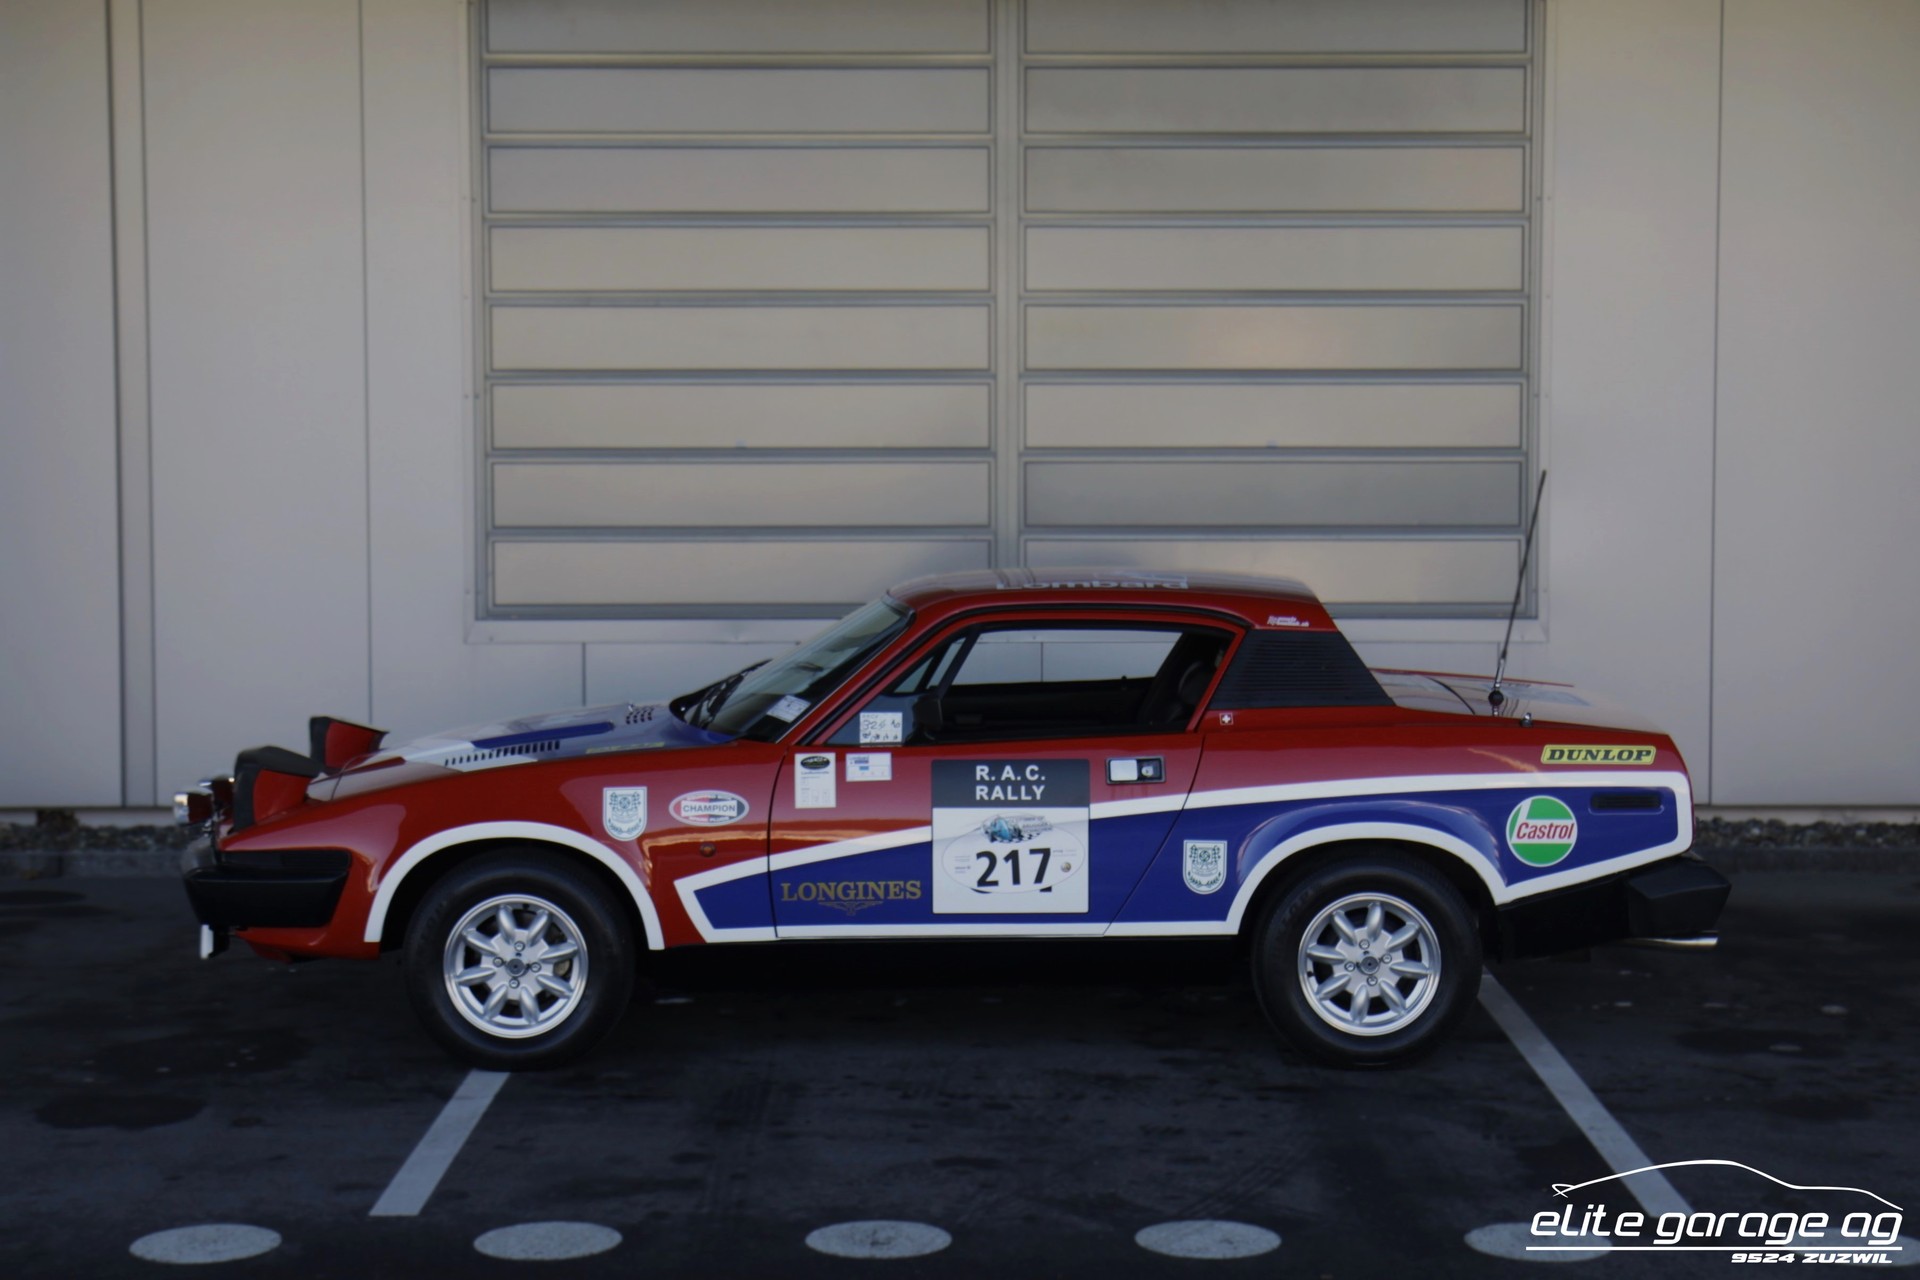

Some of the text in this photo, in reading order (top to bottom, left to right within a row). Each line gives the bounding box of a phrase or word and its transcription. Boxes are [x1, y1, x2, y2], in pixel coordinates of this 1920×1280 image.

[1547, 748, 1652, 761] DUNLOP
[975, 785, 1046, 801] RALLY
[682, 804, 736, 813] CHAMPION
[1516, 821, 1575, 840] Castrol
[976, 847, 1051, 887] 217
[781, 880, 922, 901] LONGINES
